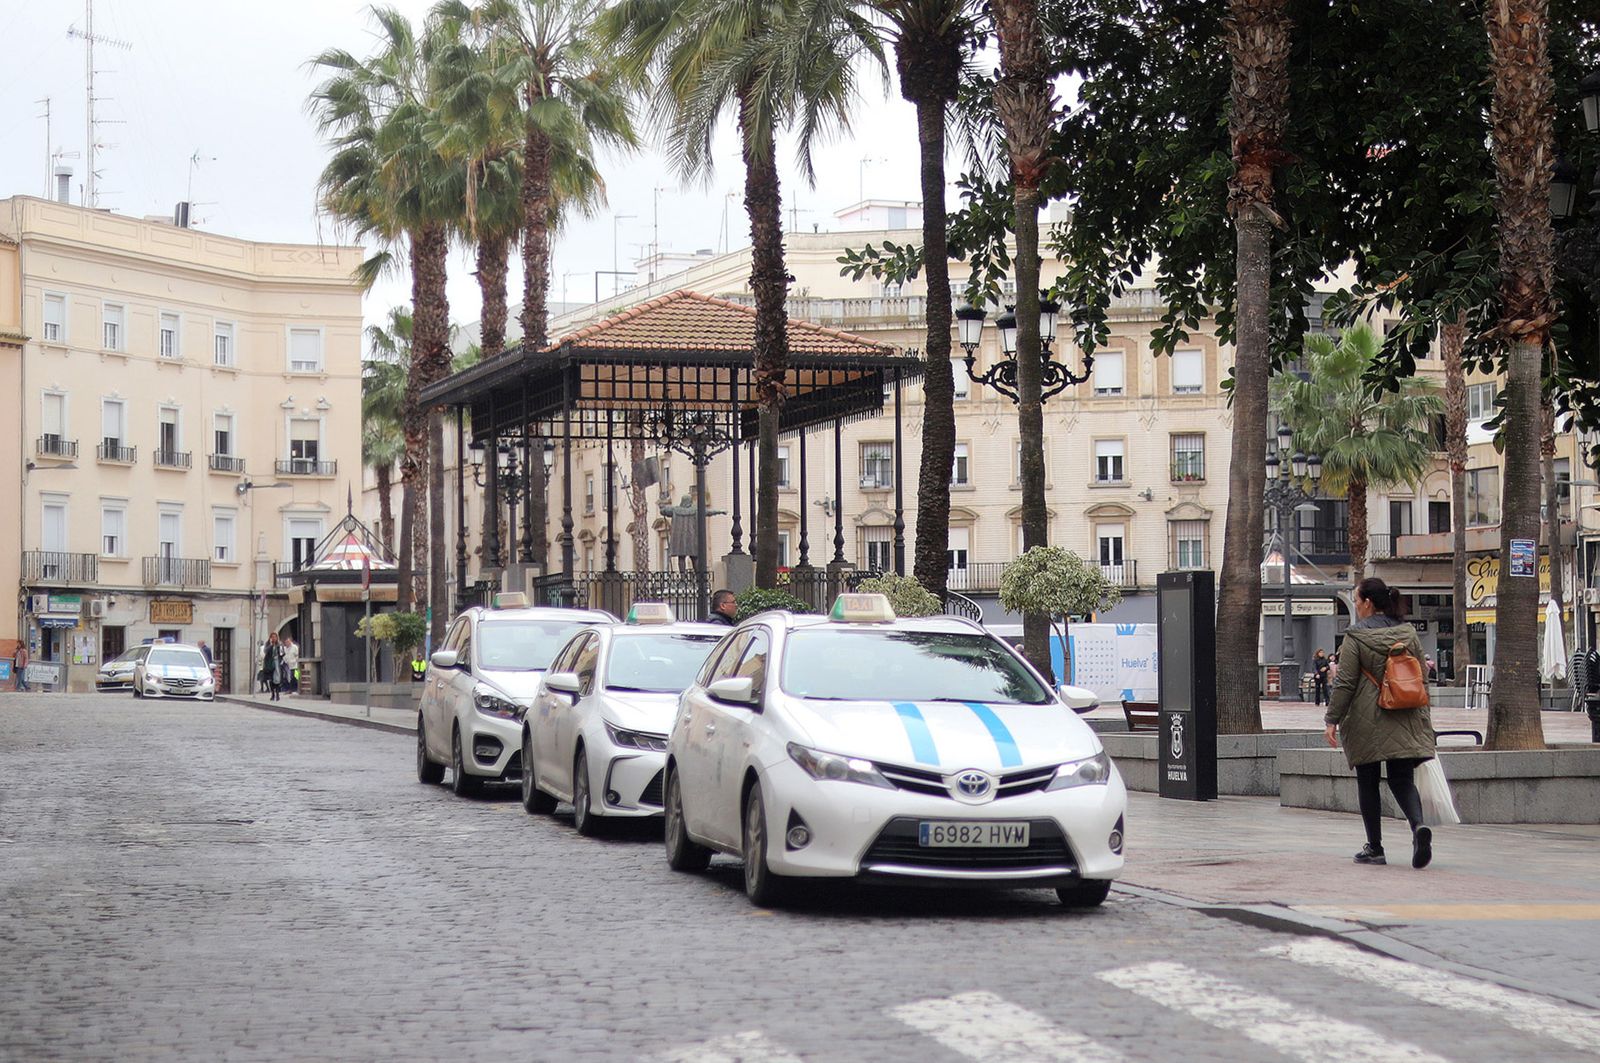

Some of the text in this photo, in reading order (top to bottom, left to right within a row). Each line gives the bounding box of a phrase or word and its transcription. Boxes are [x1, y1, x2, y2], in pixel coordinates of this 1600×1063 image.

[846, 598, 873, 610] TAXI
[1121, 657, 1147, 669] Huelva
[1167, 770, 1187, 781] HUELVA
[933, 825, 982, 844] 6982
[989, 825, 1026, 844] HVM
